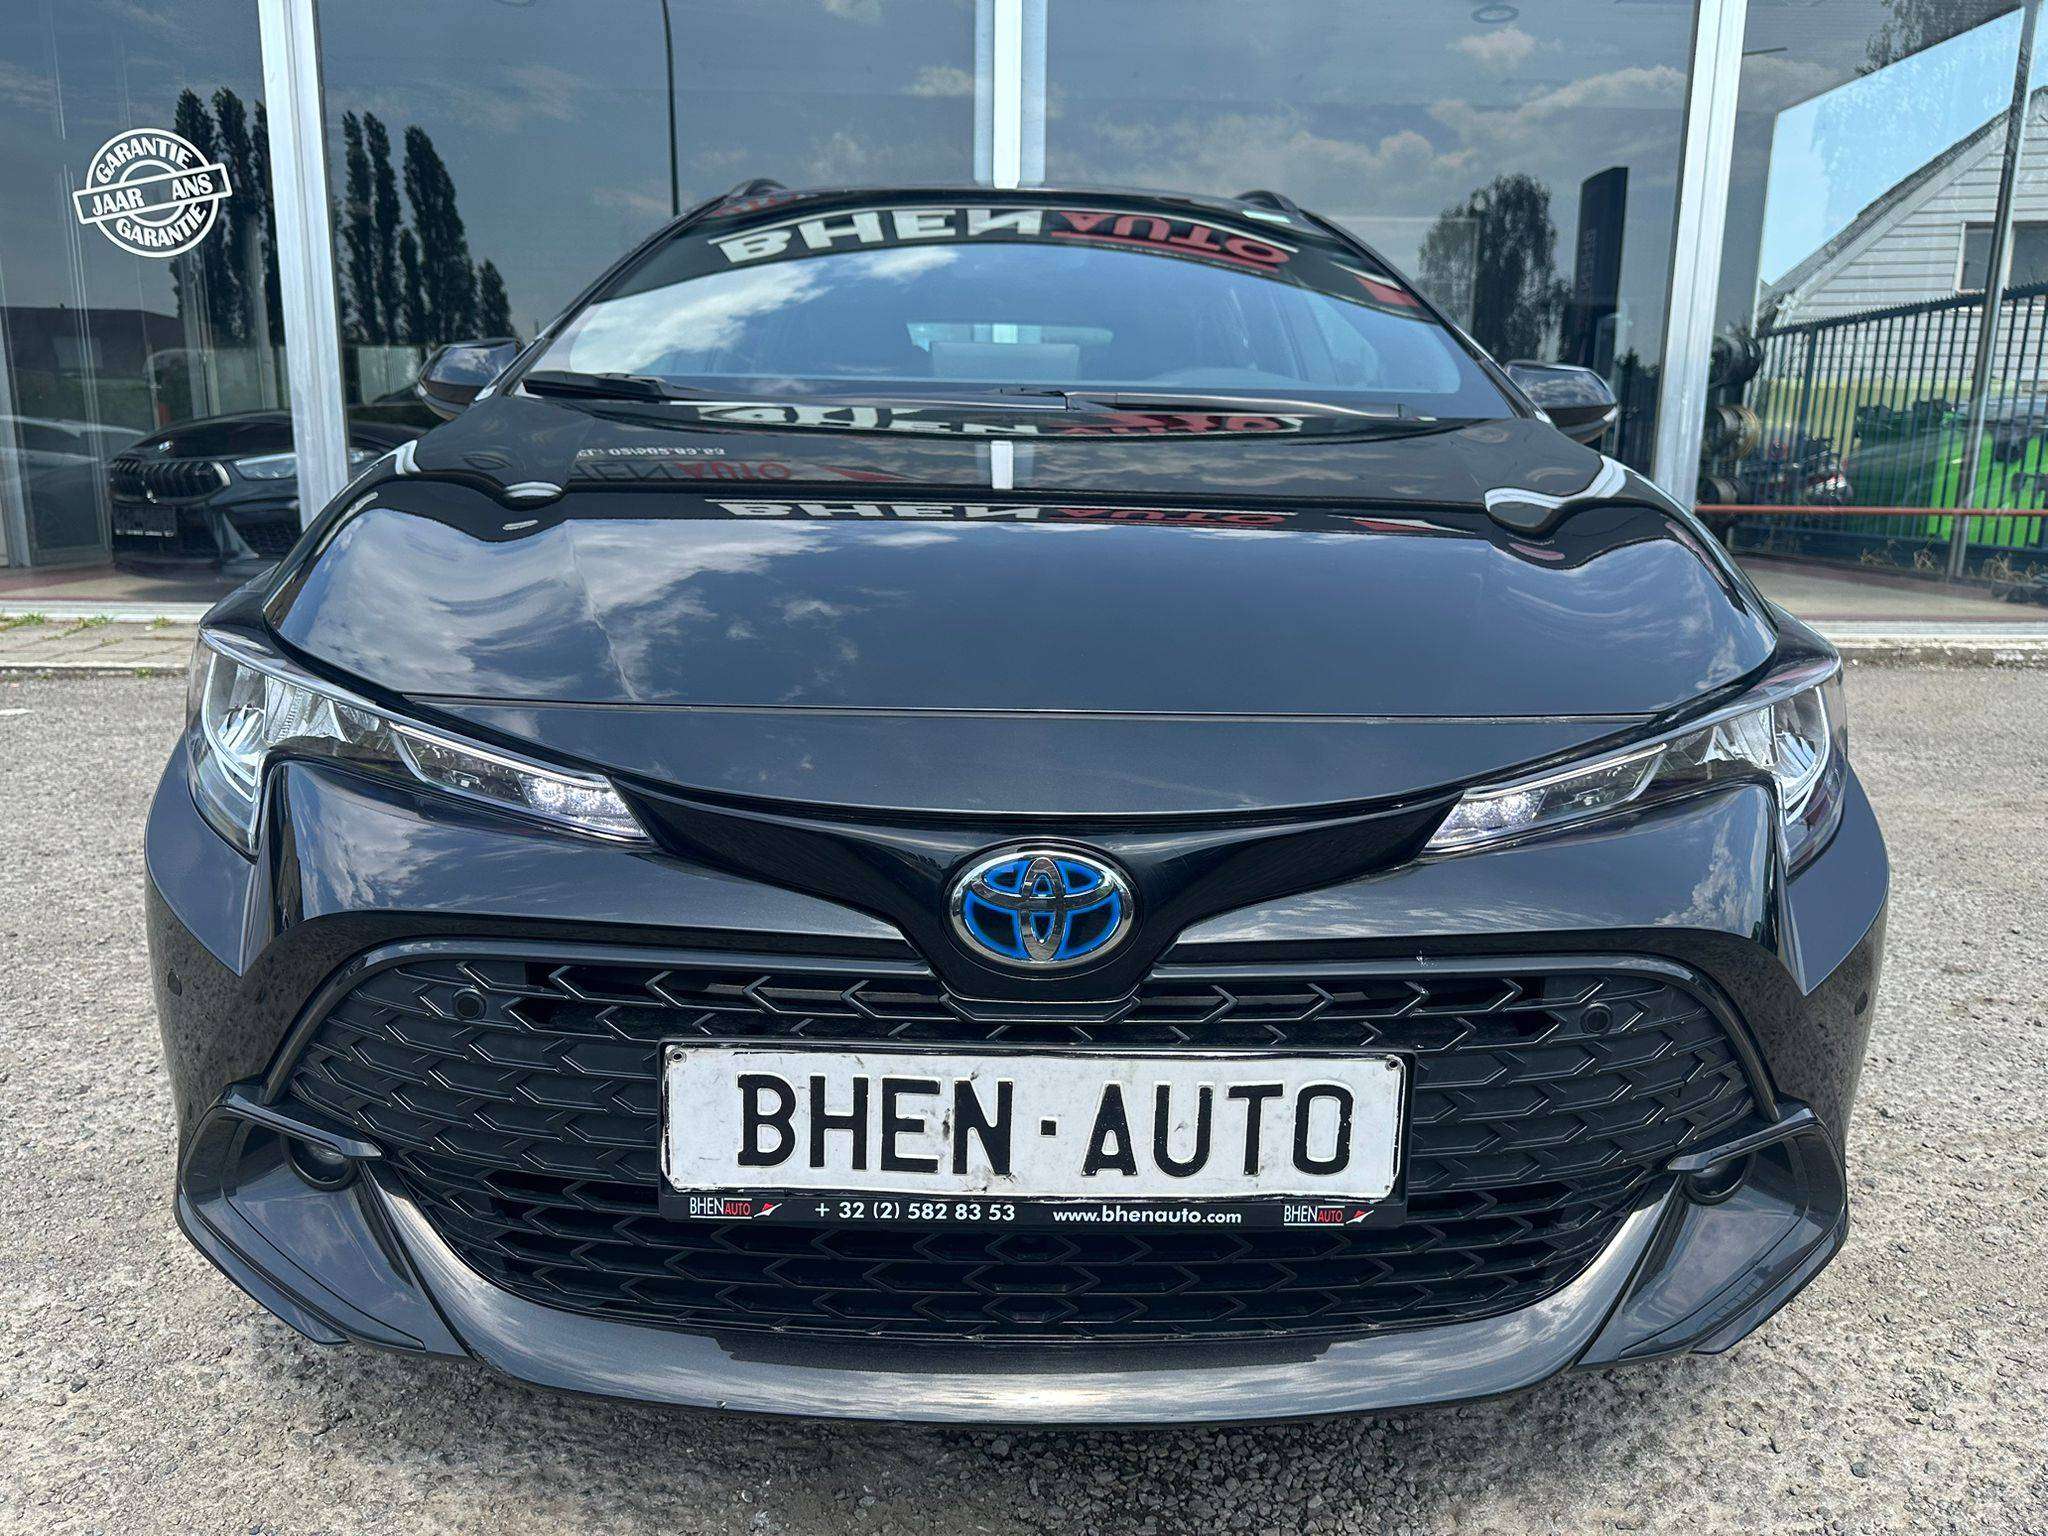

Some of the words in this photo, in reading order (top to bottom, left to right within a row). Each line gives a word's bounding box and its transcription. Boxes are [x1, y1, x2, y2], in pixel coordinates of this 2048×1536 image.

[95, 136, 193, 184] GARANTIE
[92, 187, 145, 216] JAAR
[171, 173, 213, 200] ANS
[115, 202, 207, 247] GARANTIE
[737, 1073, 1014, 1176] BHEN
[1081, 1082, 1355, 1178] AUTO
[838, 1201, 865, 1219] 32
[873, 1201, 900, 1219] (2)
[907, 1202, 947, 1220] 582
[954, 1203, 981, 1221] 83
[988, 1203, 1016, 1222] 53
[1053, 1204, 1242, 1224] www.bhenauto.com
